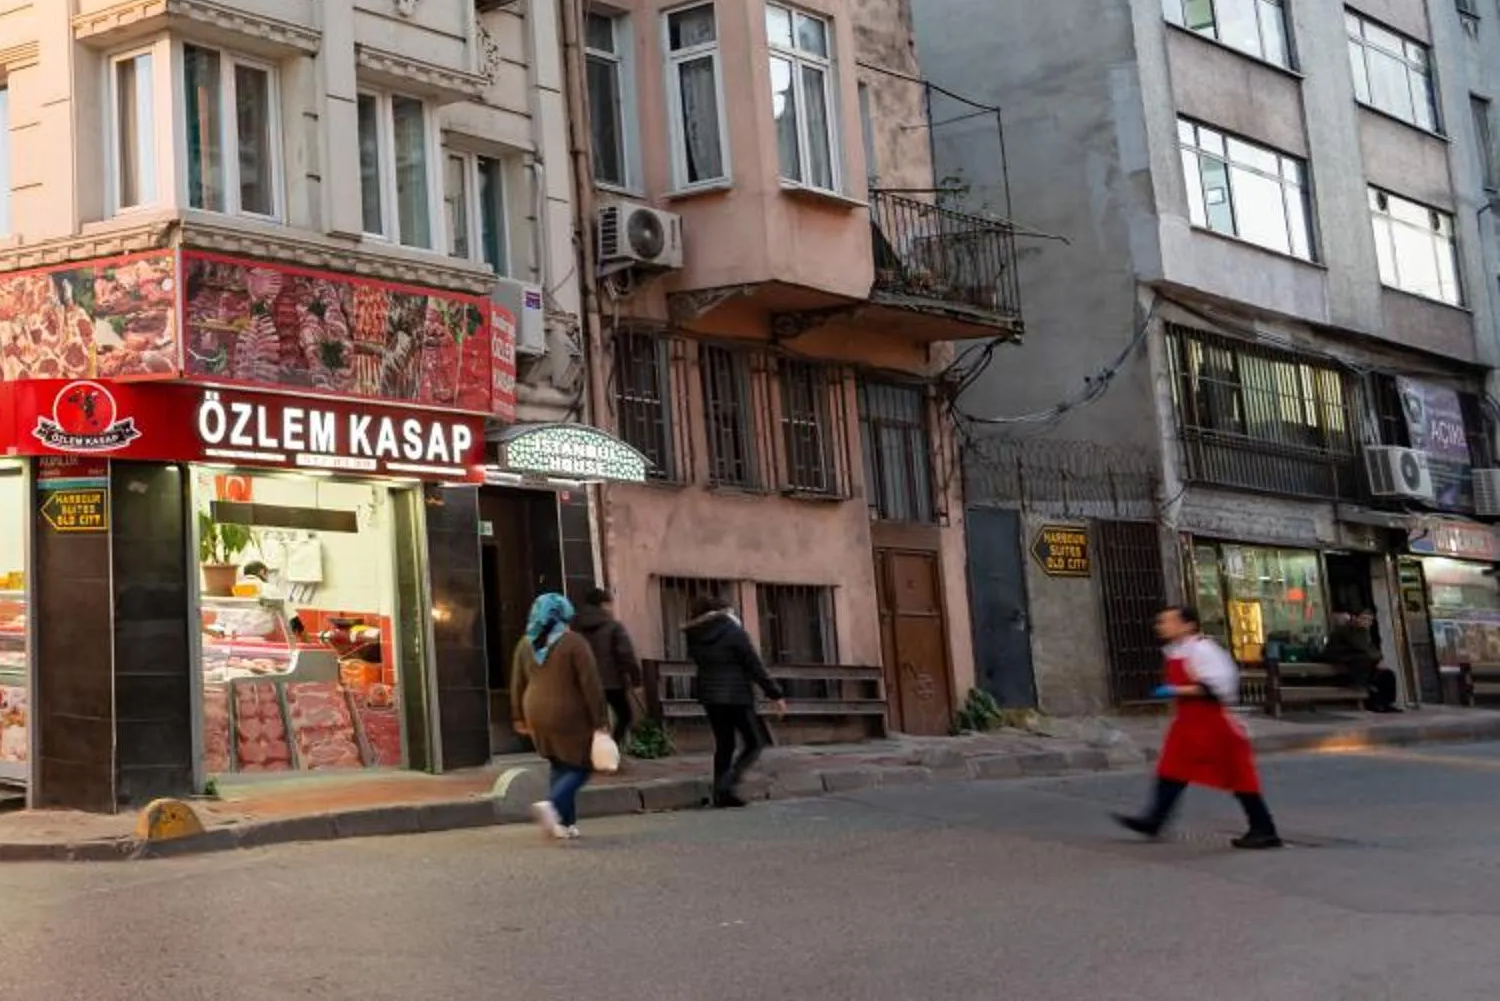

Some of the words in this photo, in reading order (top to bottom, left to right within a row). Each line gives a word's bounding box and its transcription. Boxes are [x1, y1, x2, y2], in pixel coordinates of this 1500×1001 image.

[199, 391, 336, 454] ÖZLEM
[350, 414, 473, 464] KASAP
[548, 457, 608, 475] HOUSE
[80, 515, 101, 525] CITY
